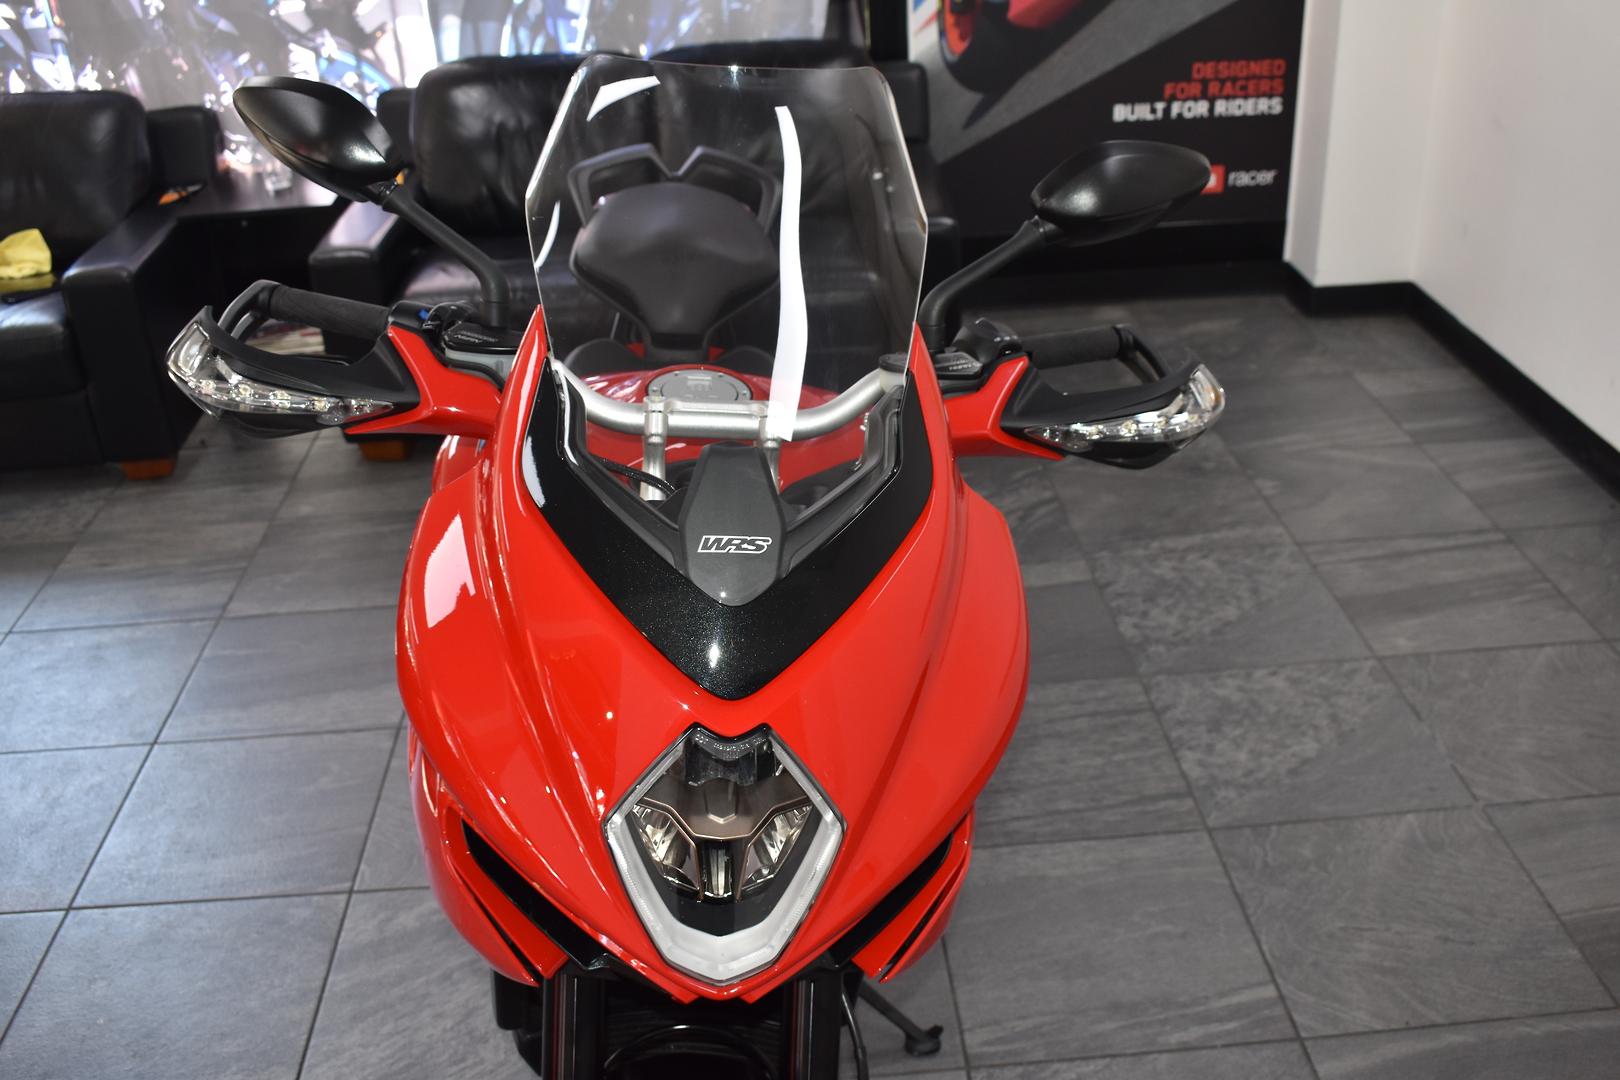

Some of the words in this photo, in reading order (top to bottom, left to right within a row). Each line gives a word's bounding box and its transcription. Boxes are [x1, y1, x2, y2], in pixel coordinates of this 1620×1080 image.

[1192, 59, 1286, 79] DESIGNED
[1164, 82, 1203, 99] FOR
[1208, 78, 1284, 97] RACERS
[1112, 102, 1167, 122] BUILT
[1170, 100, 1210, 119] FOR
[1214, 96, 1283, 117] RIDERS
[1228, 169, 1278, 187] racer
[697, 535, 772, 553] WRS
